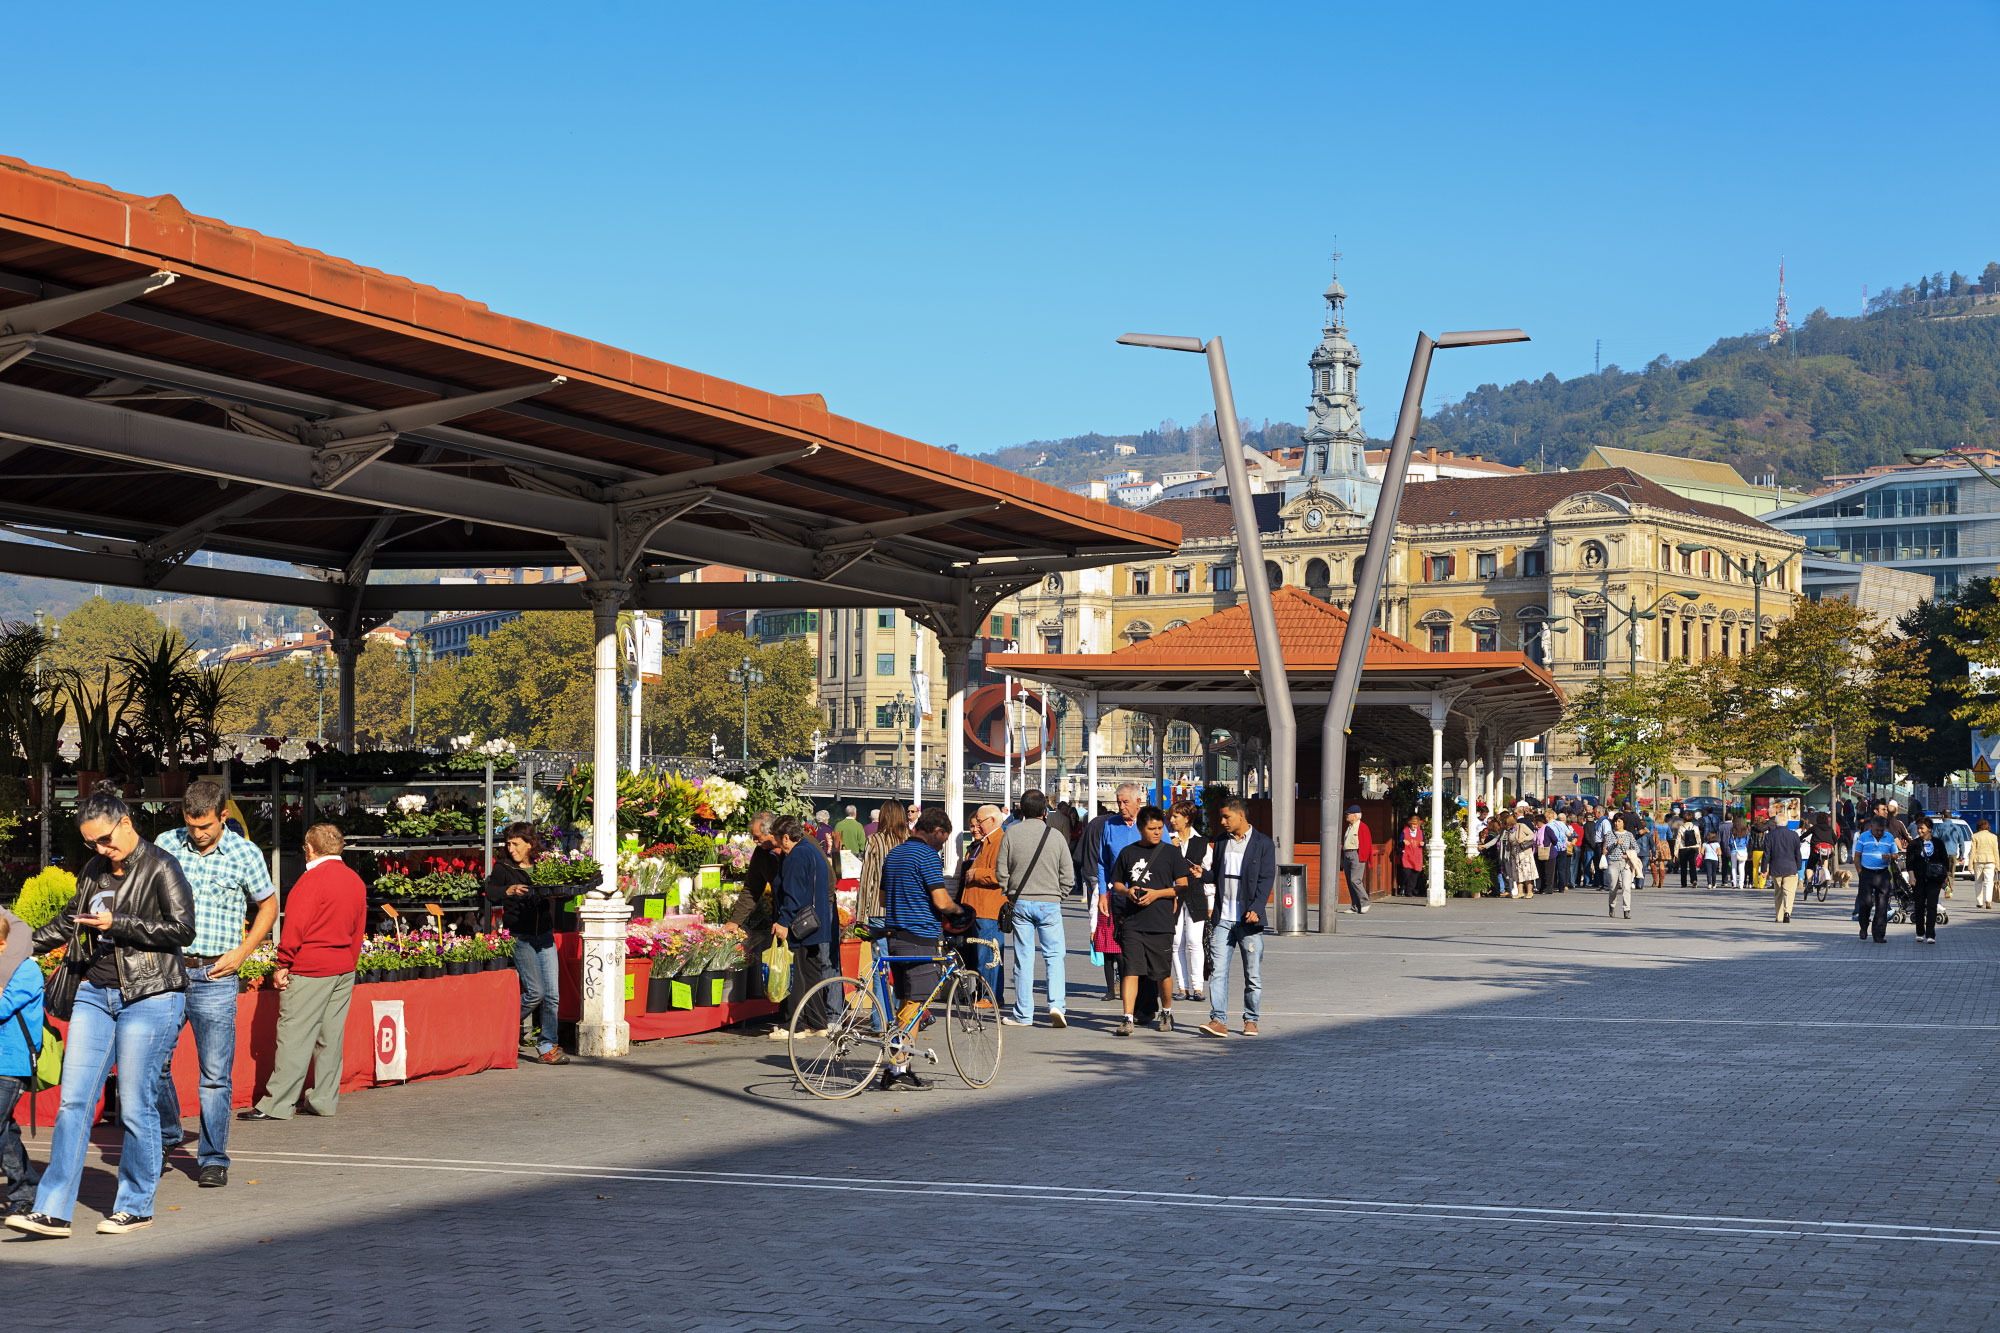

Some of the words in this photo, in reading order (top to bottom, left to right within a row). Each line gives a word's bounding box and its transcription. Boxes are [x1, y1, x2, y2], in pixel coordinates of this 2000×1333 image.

[645, 623, 651, 636] A
[625, 627, 637, 661] A
[1285, 896, 1292, 905] B
[381, 1027, 393, 1053] B
